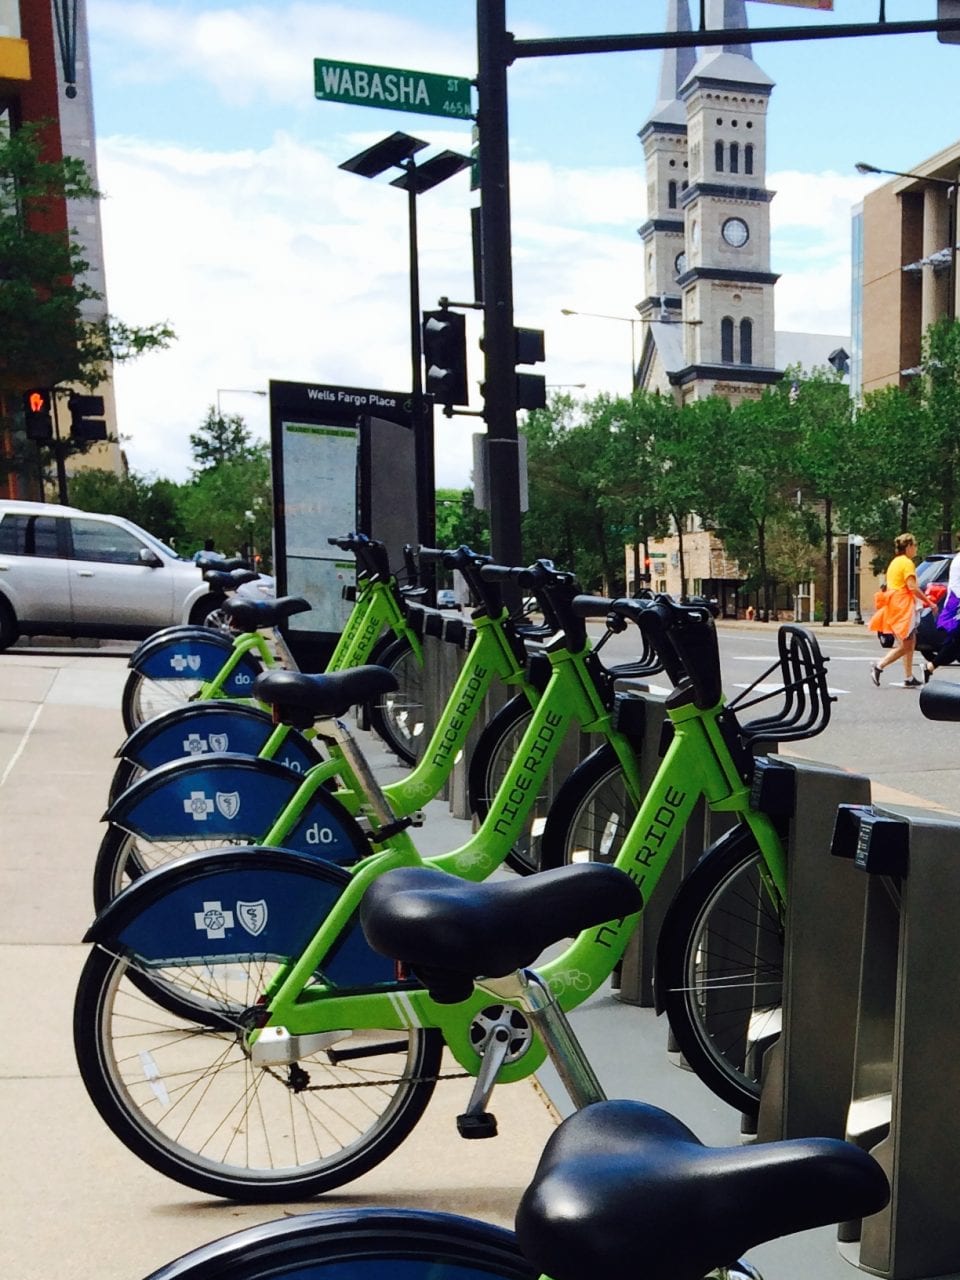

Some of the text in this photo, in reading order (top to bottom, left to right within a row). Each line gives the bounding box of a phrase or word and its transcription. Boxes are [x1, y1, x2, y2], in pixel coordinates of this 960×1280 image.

[322, 66, 459, 106] WABASHA ST
[307, 389, 396, 407] Wells Fargo Place
[356, 616, 380, 652] RIDE
[432, 664, 488, 767] NICE RIDE
[493, 710, 563, 835] NICE RIDE
[305, 822, 339, 844] do.
[635, 785, 686, 868] RIDE
